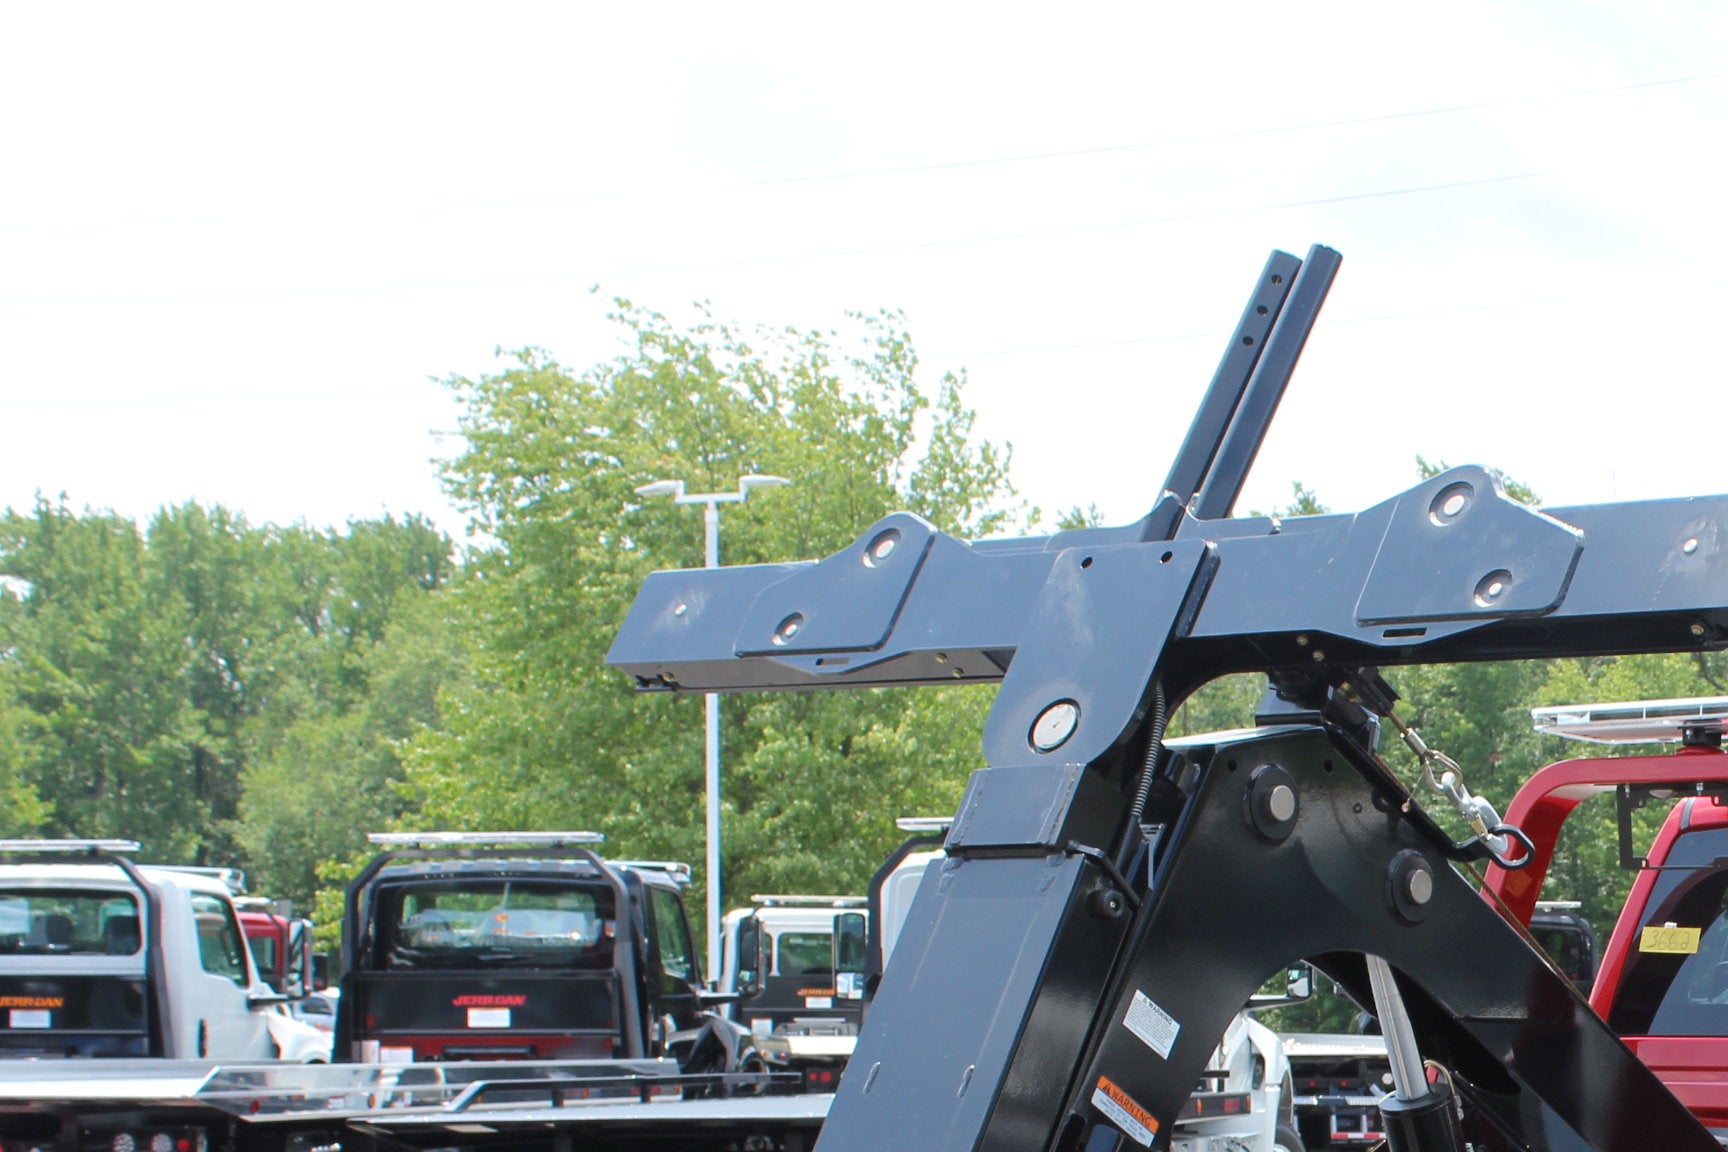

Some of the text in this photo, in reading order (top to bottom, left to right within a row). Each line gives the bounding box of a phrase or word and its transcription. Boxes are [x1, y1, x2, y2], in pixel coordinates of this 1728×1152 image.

[1646, 929, 1690, 951] 3662
[1148, 1001, 1173, 1026] WARNING
[1111, 1088, 1152, 1129] WARNING
